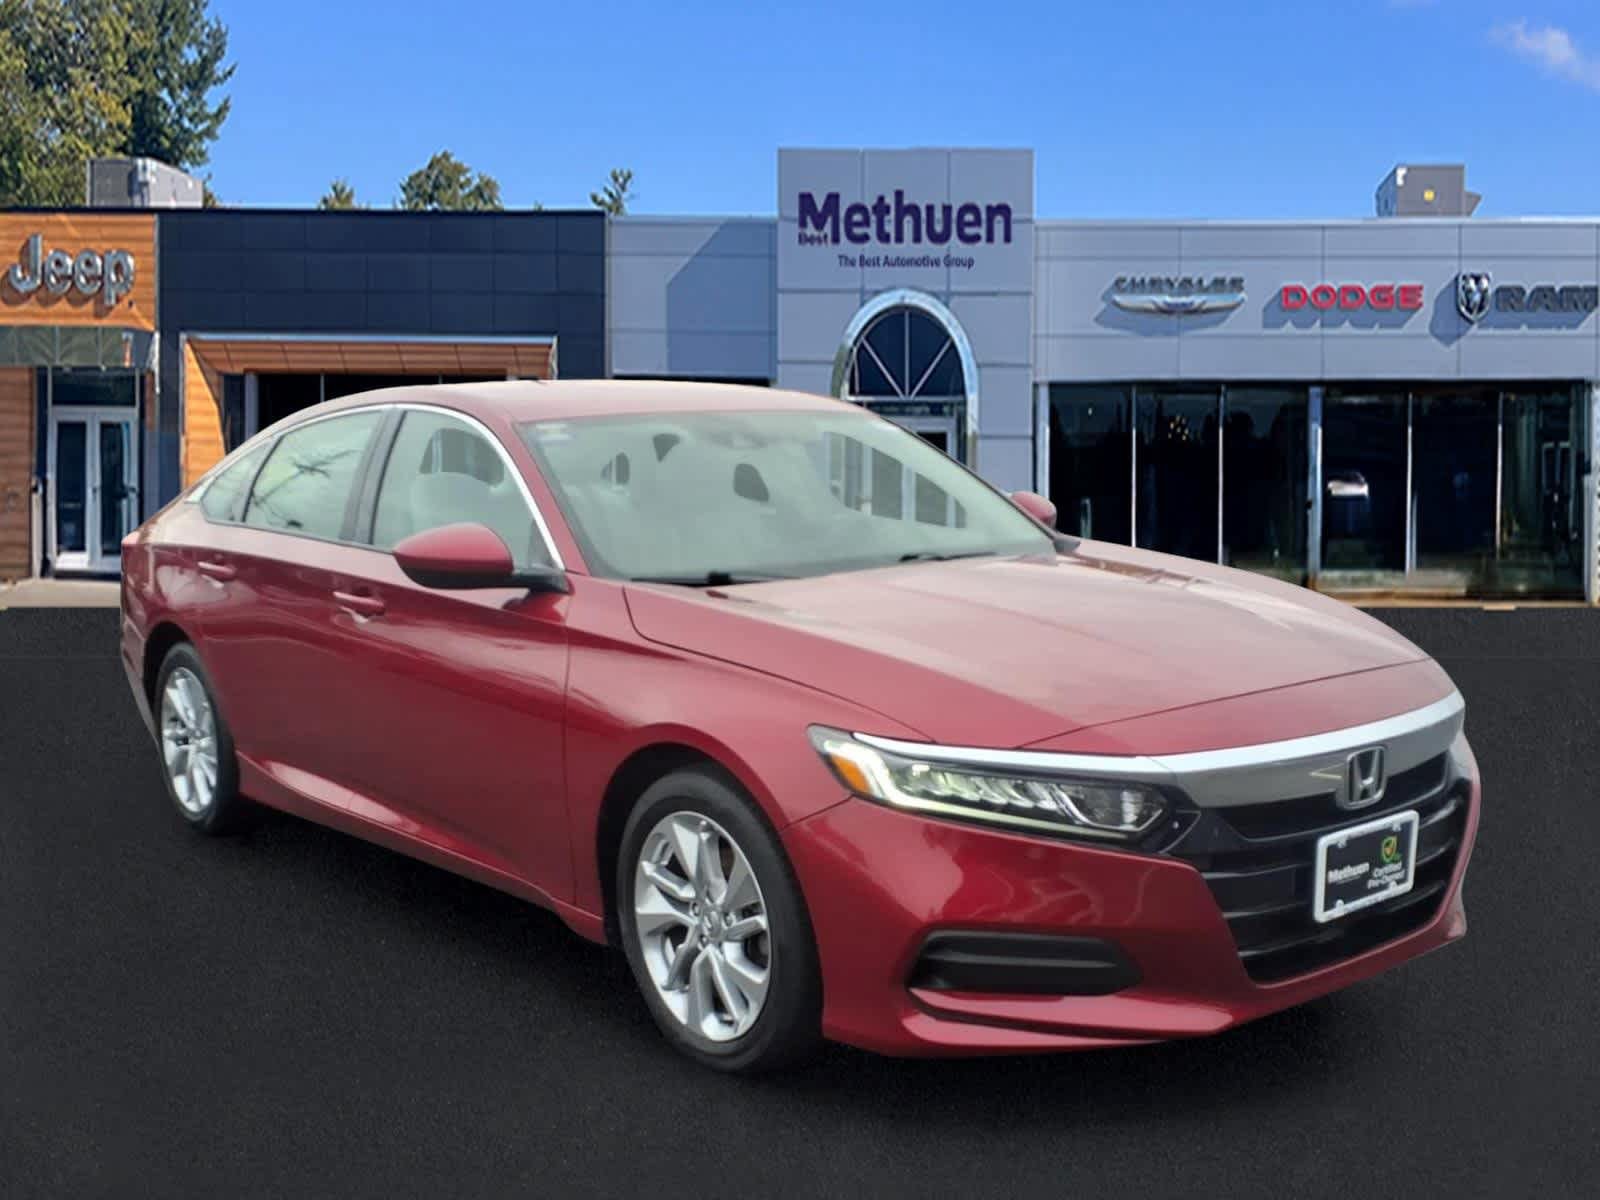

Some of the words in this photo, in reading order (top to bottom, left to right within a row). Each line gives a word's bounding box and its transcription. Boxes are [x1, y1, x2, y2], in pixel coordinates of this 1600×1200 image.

[798, 189, 1012, 244] Methuen
[9, 233, 135, 306] Jeep
[838, 255, 856, 267] The
[859, 255, 880, 267] Best
[883, 255, 941, 268] Automotive
[943, 255, 975, 269] Group
[1281, 284, 1424, 311] DODGE
[1495, 285, 1599, 312] RAM
